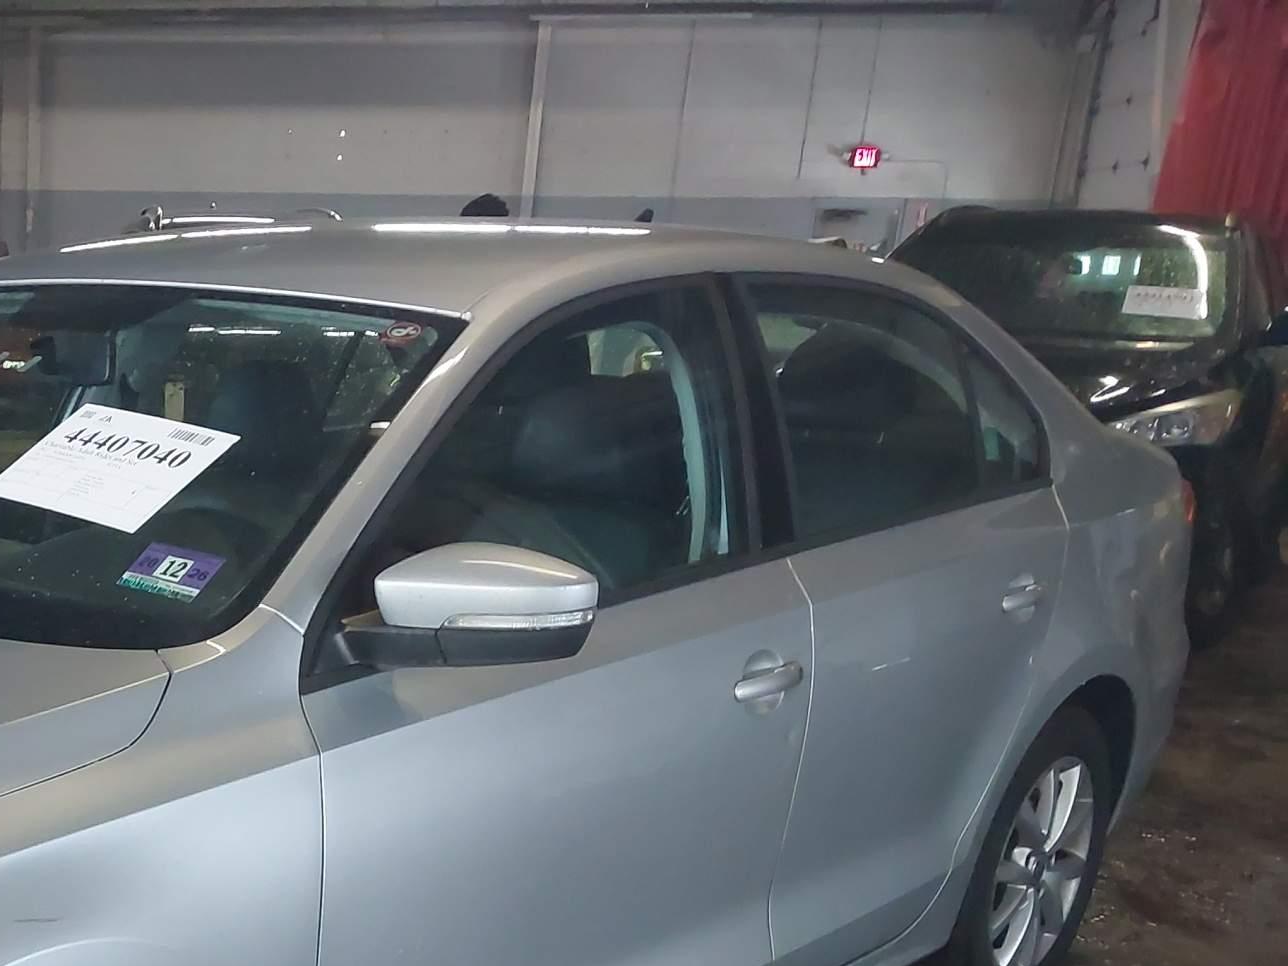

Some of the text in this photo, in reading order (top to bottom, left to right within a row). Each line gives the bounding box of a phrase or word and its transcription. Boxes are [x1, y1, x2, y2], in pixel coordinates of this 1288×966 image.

[854, 148, 878, 167] EXIT
[64, 427, 192, 469] 44407040
[159, 559, 188, 579] 12
